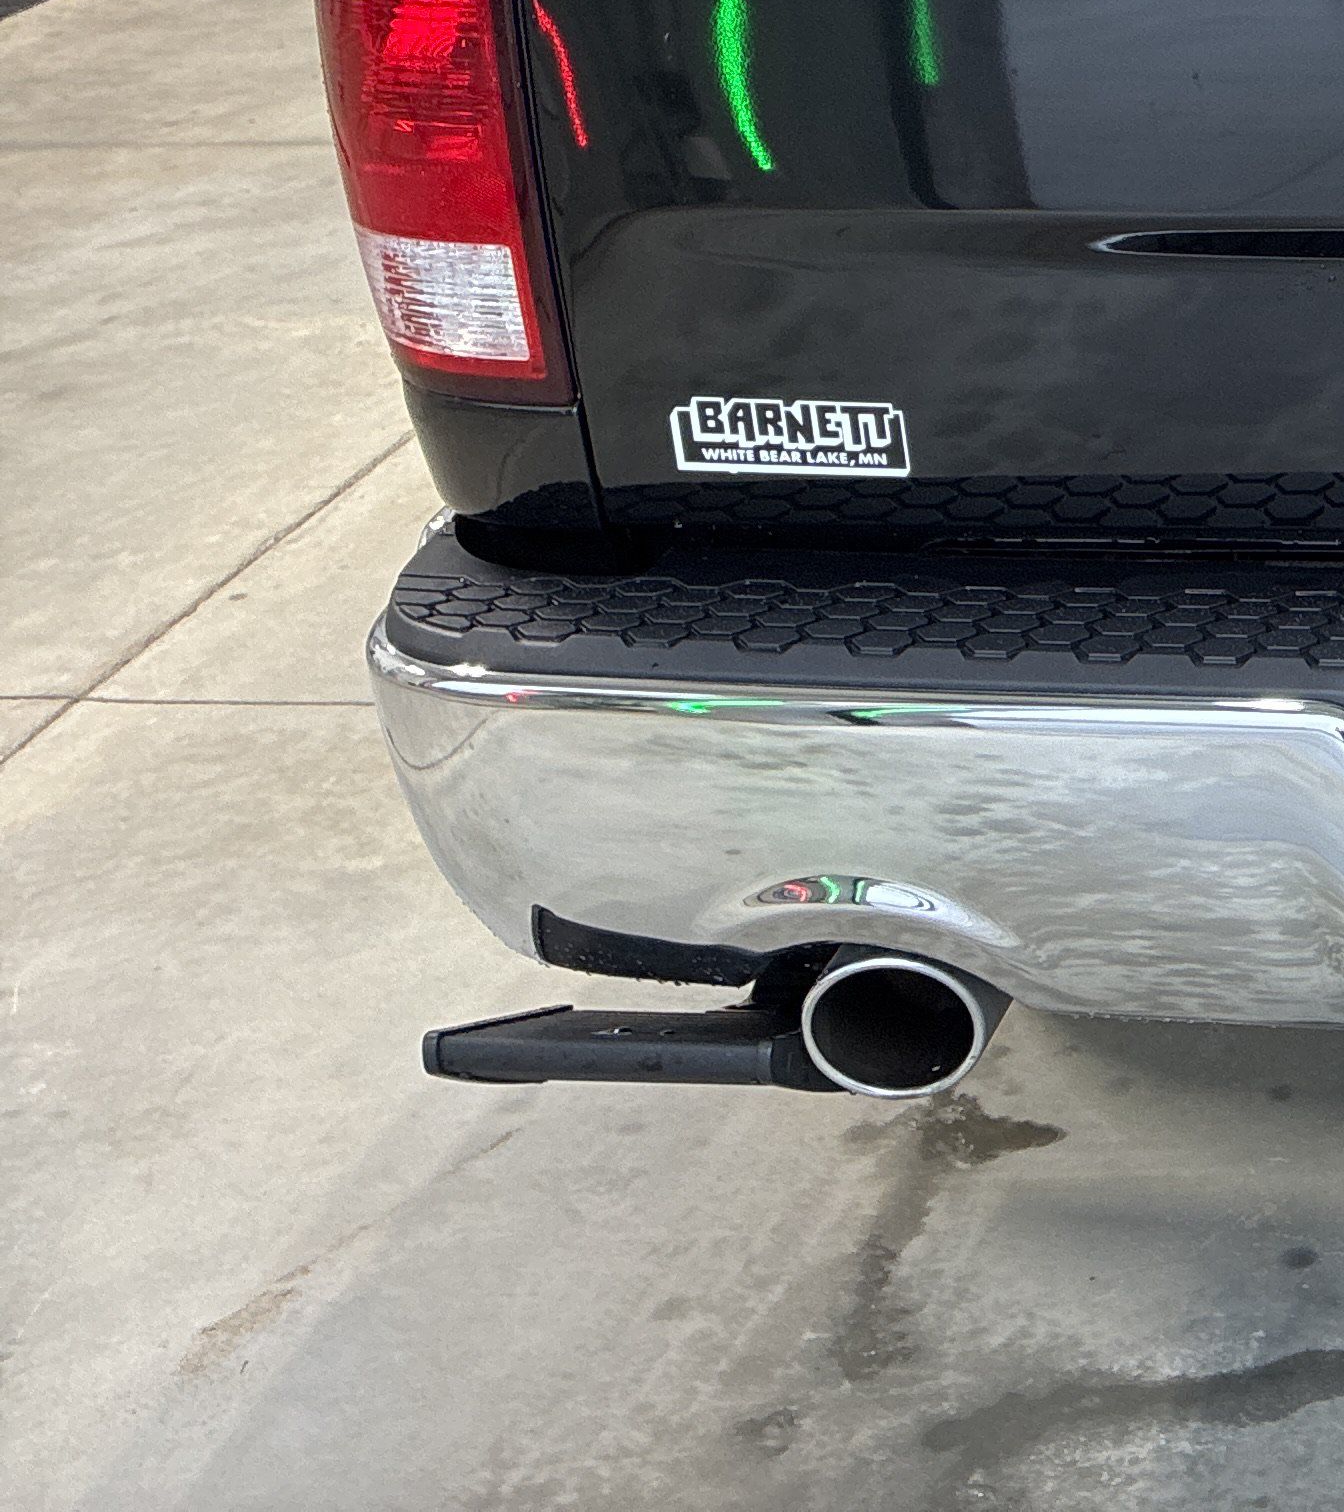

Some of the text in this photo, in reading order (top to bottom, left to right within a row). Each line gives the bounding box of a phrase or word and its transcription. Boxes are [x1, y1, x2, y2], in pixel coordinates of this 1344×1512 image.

[694, 398, 892, 449] BARNETT
[700, 447, 888, 467] WHITE BEAR LAKE, MN
